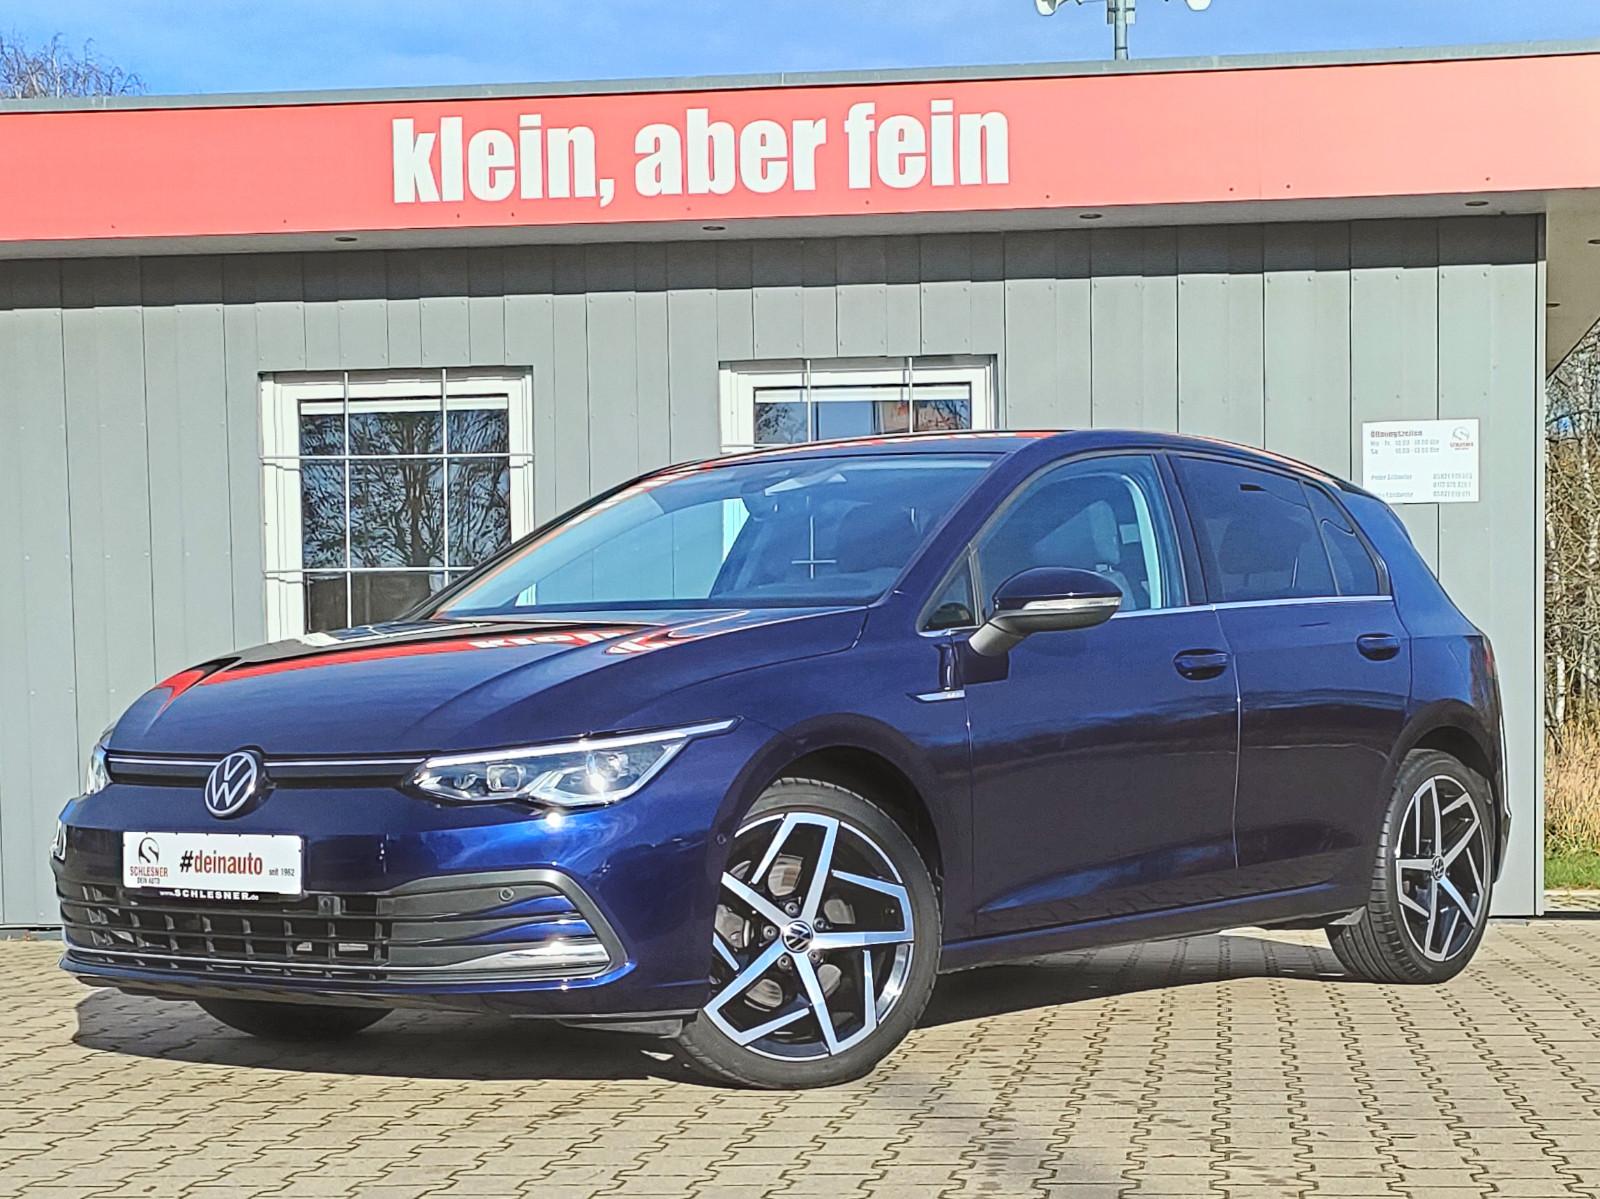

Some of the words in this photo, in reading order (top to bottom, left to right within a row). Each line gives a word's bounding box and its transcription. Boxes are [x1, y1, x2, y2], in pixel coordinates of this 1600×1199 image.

[392, 114, 615, 208] klein,
[634, 108, 827, 195] aber
[844, 99, 1010, 189] fein
[130, 866, 168, 877] SCHLESNER
[180, 850, 263, 875] #deinauto
